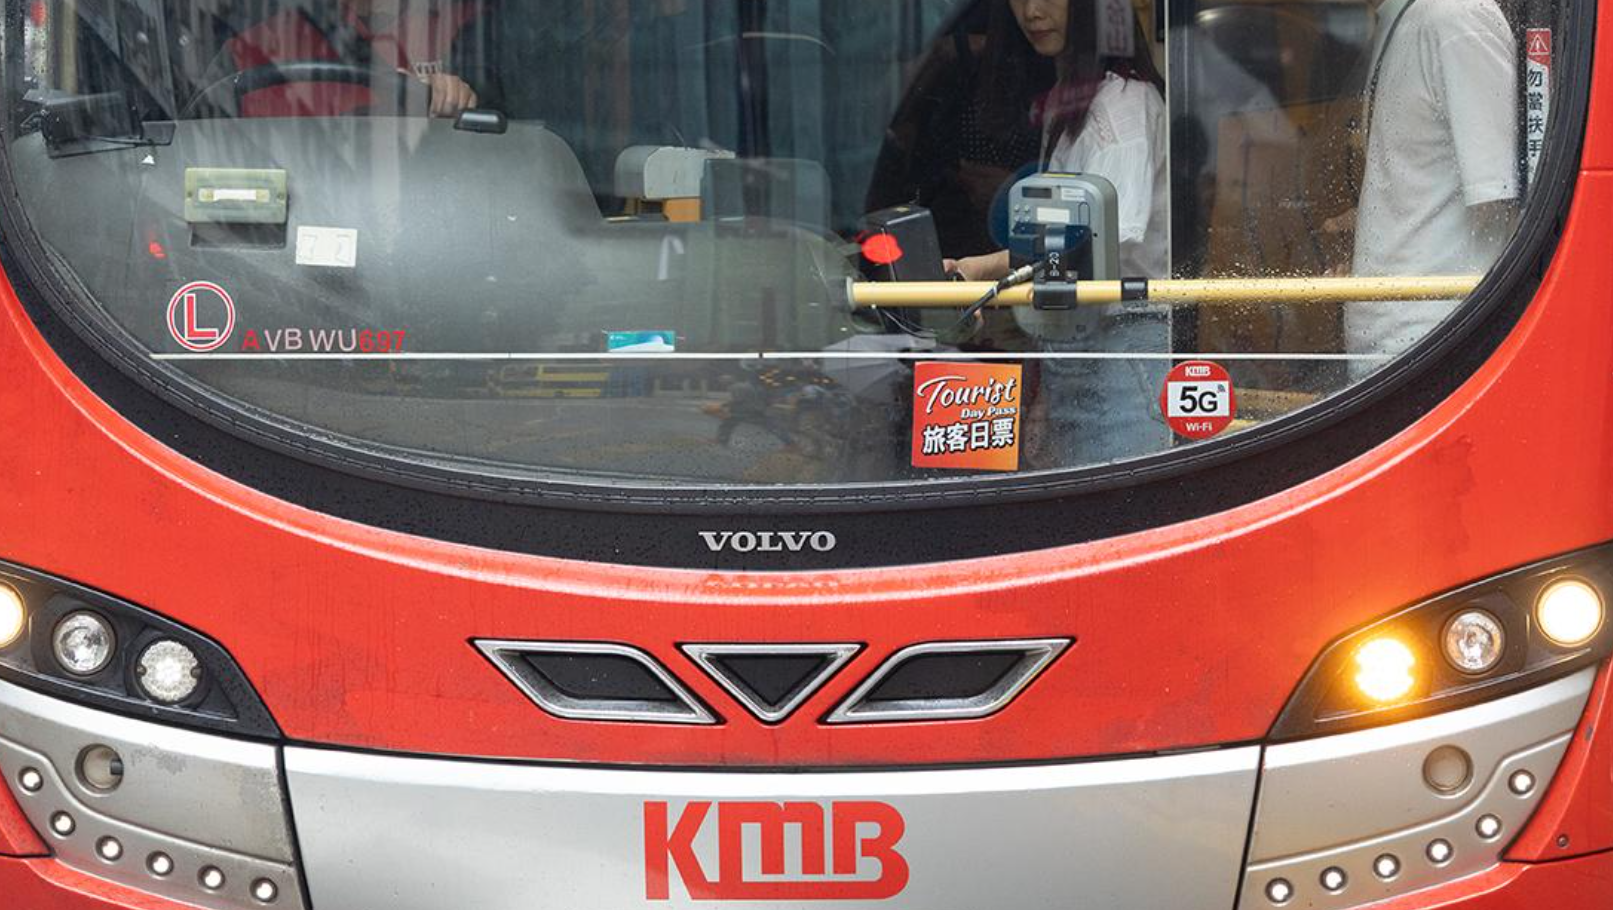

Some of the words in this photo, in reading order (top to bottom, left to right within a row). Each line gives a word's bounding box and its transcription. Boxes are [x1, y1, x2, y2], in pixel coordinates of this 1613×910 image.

[1527, 69, 1544, 157] 勿當扶手
[184, 293, 219, 340] L
[1184, 366, 1211, 377] KMB
[917, 375, 1016, 414] Tourist
[1179, 386, 1218, 413] 5G
[961, 408, 986, 420] Day
[988, 406, 1016, 416] Pass
[1186, 422, 1213, 432] Wi-Fi
[922, 417, 1015, 455] 旅客日票
[698, 531, 836, 551] VOLVO
[643, 801, 910, 900] KMB
